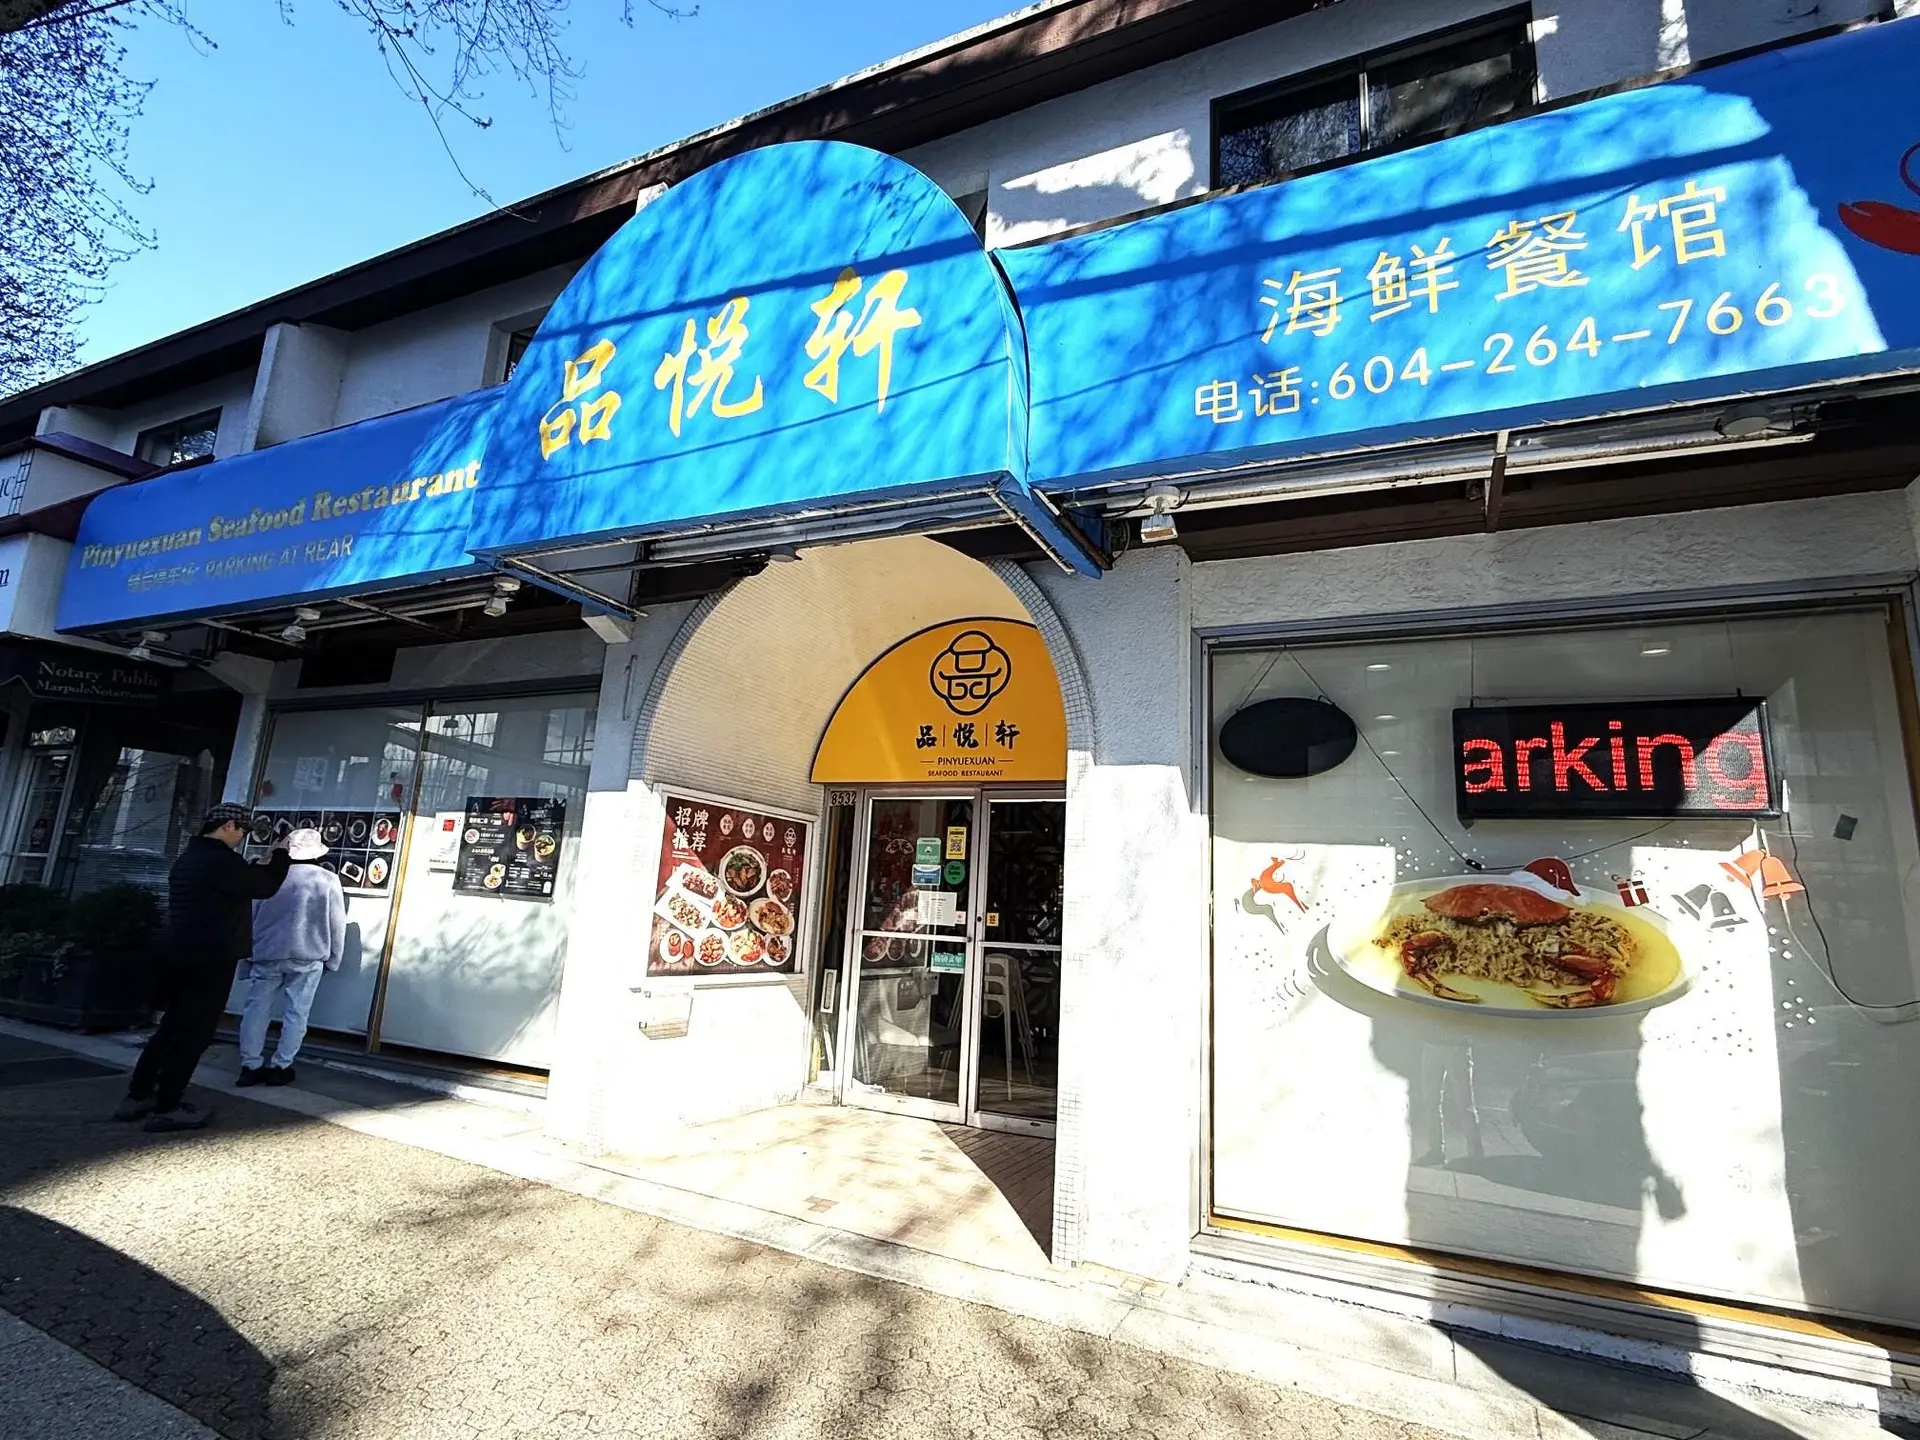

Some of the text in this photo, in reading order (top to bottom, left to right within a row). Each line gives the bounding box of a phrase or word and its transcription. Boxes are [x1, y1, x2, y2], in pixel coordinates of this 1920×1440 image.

[1257, 181, 1729, 345] 海鲜餐馆
[539, 266, 922, 460] 品悦轩
[80, 460, 482, 569] Pinyuexuan Seafood Restaurant
[205, 553, 275, 578] PARKING
[279, 547, 297, 566] AT
[304, 535, 353, 562] REAR
[38, 661, 161, 687] Notary Public
[927, 769, 1004, 777] SEAFOOD RESTAURANT
[937, 756, 996, 766] PINYUEXUAN
[1462, 719, 1769, 811] arking
[831, 791, 857, 806] 8532
[674, 805, 710, 831] 招牌
[671, 828, 707, 852] 推荐
